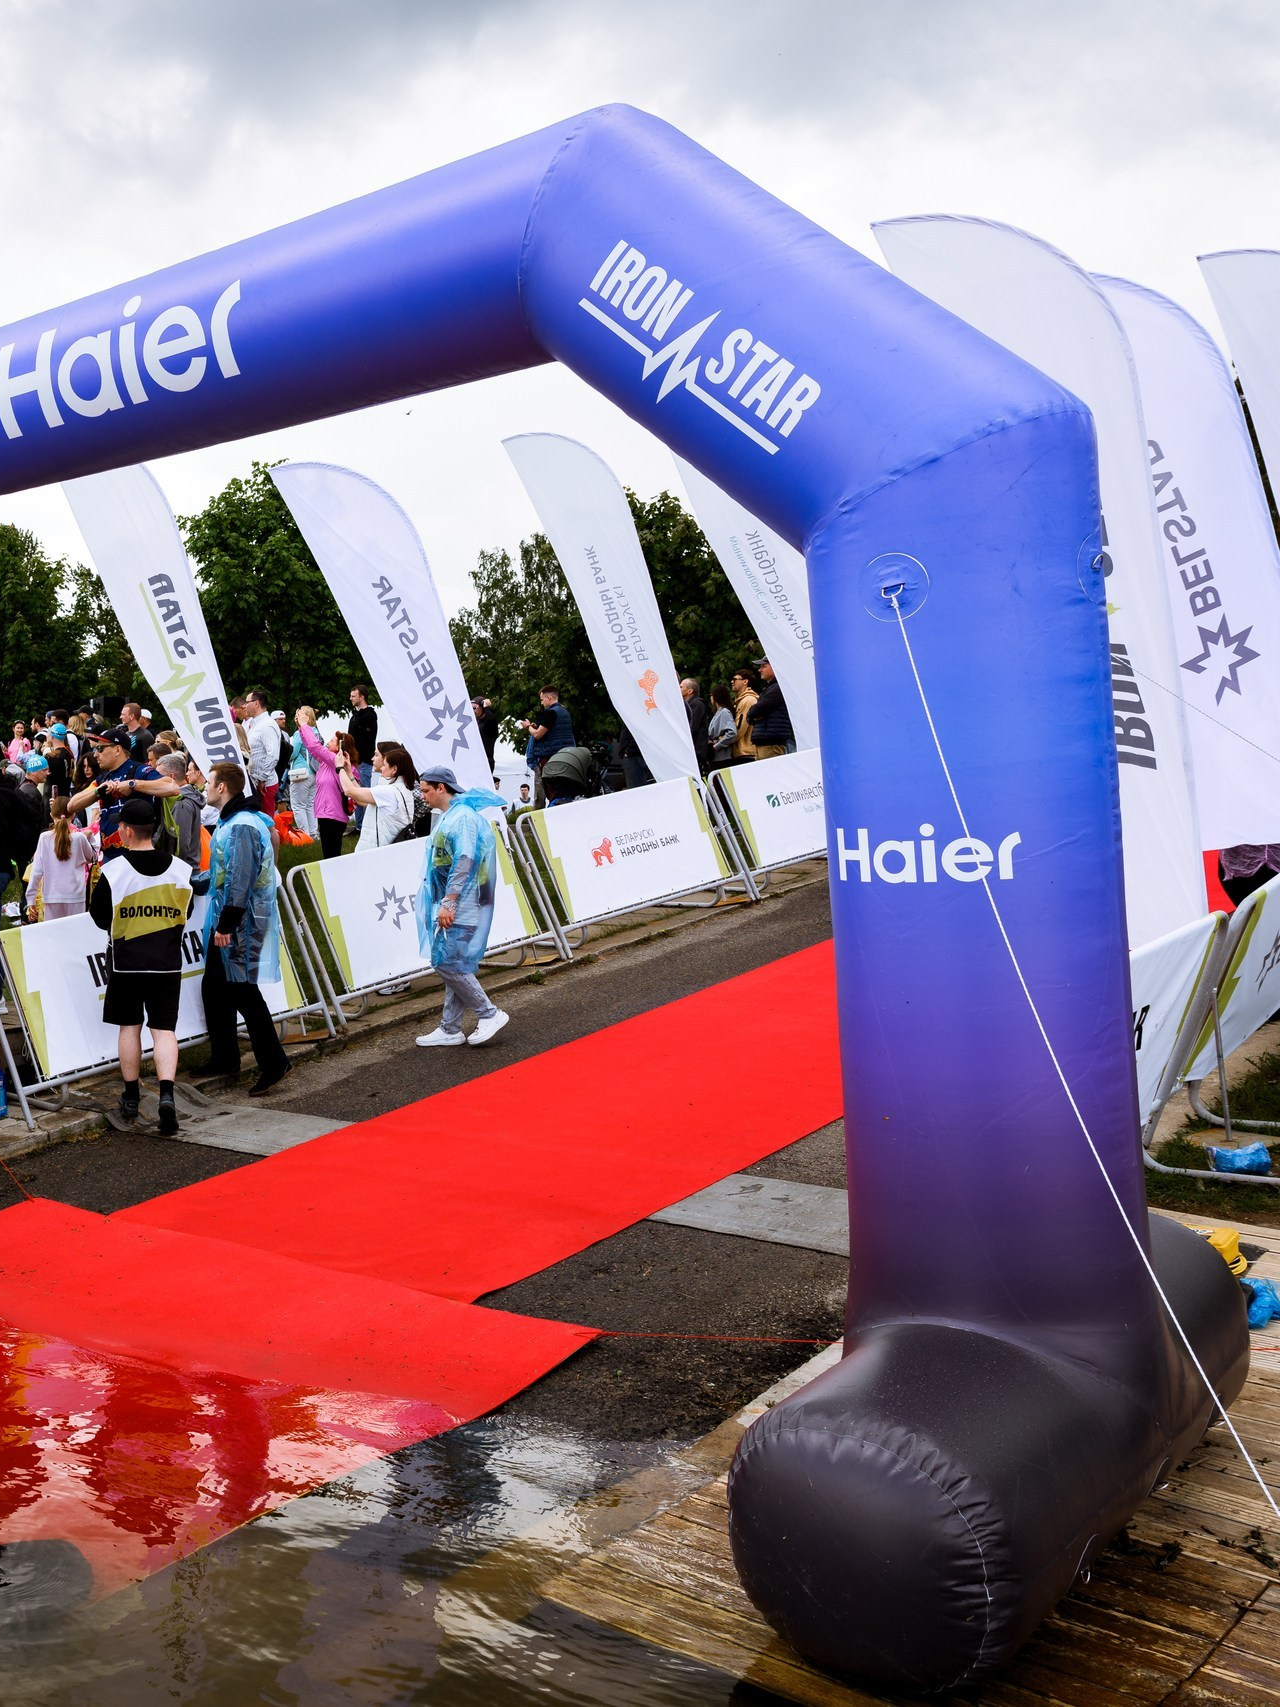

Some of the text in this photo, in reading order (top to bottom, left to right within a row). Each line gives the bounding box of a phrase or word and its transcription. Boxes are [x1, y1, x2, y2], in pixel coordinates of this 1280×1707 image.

[588, 239, 821, 439] IRON STAR
[619, 834, 681, 858] НАРОДНЫ БАНК
[835, 822, 1022, 884] Haier
[120, 905, 181, 919] ВОЛОНТЕР
